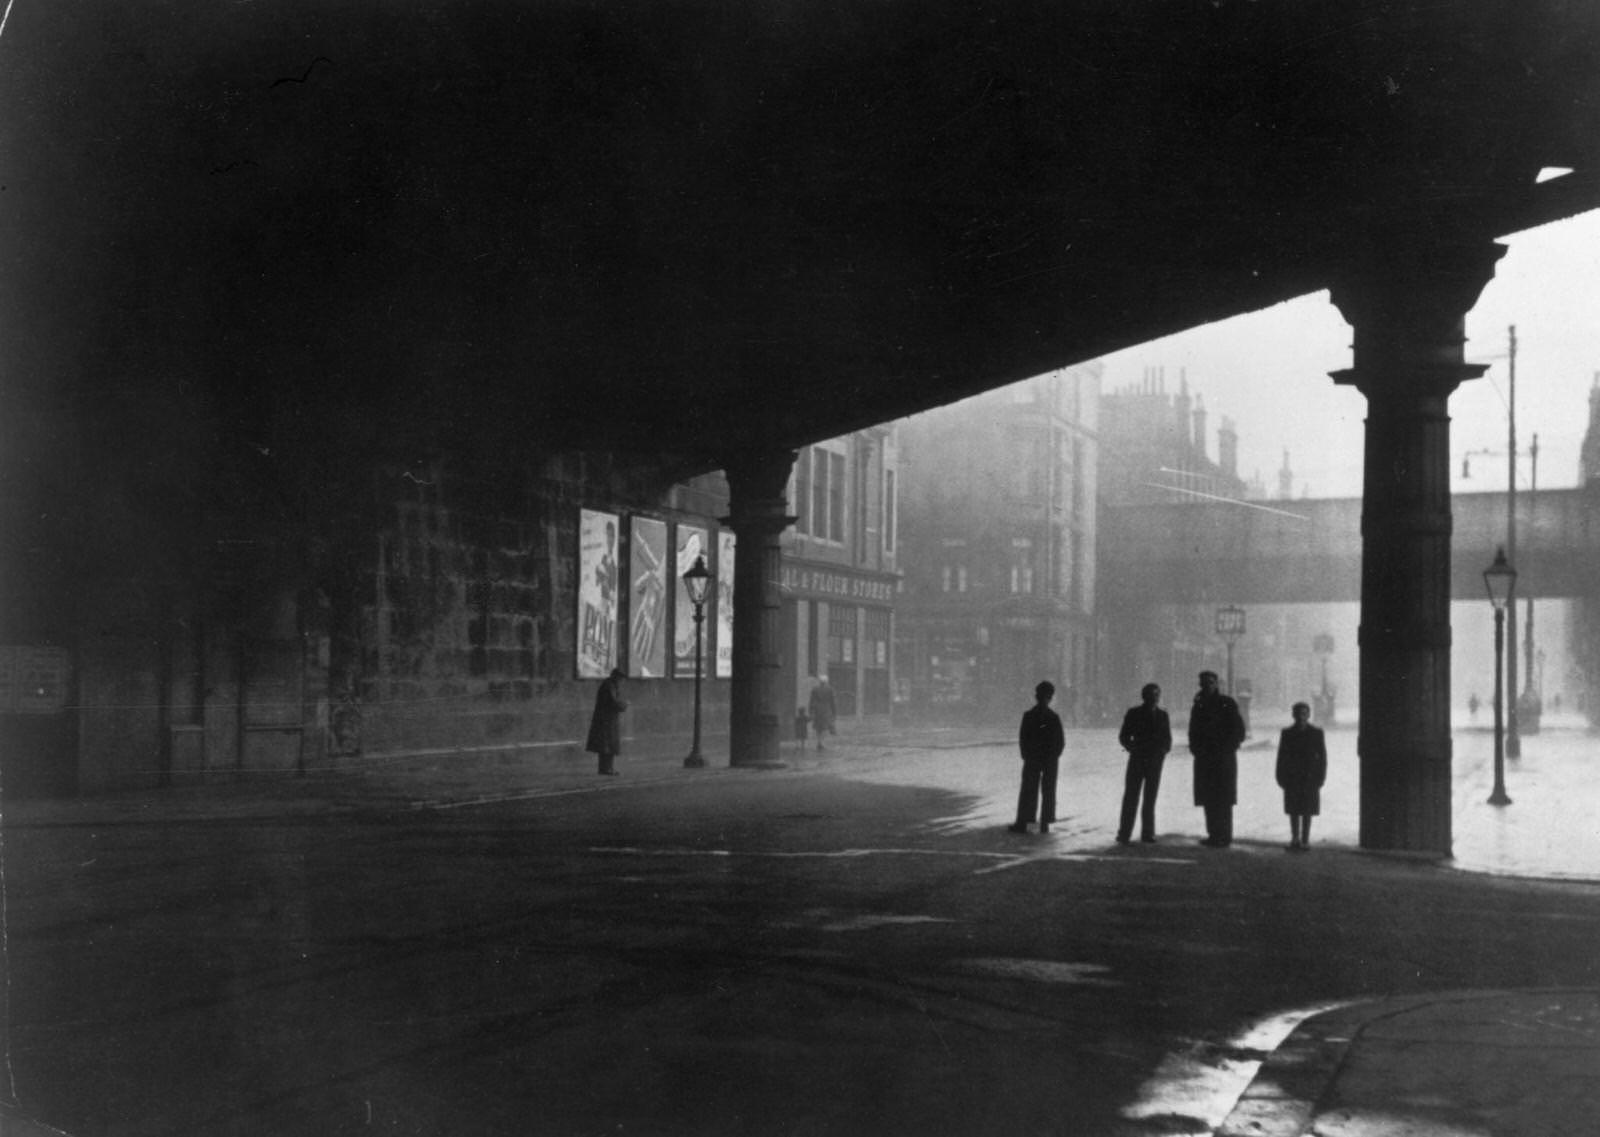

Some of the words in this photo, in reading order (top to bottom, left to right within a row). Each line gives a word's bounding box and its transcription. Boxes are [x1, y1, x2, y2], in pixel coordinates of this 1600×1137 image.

[781, 567, 797, 588] AL
[811, 572, 849, 595] FLOUR
[852, 577, 892, 600] STORES
